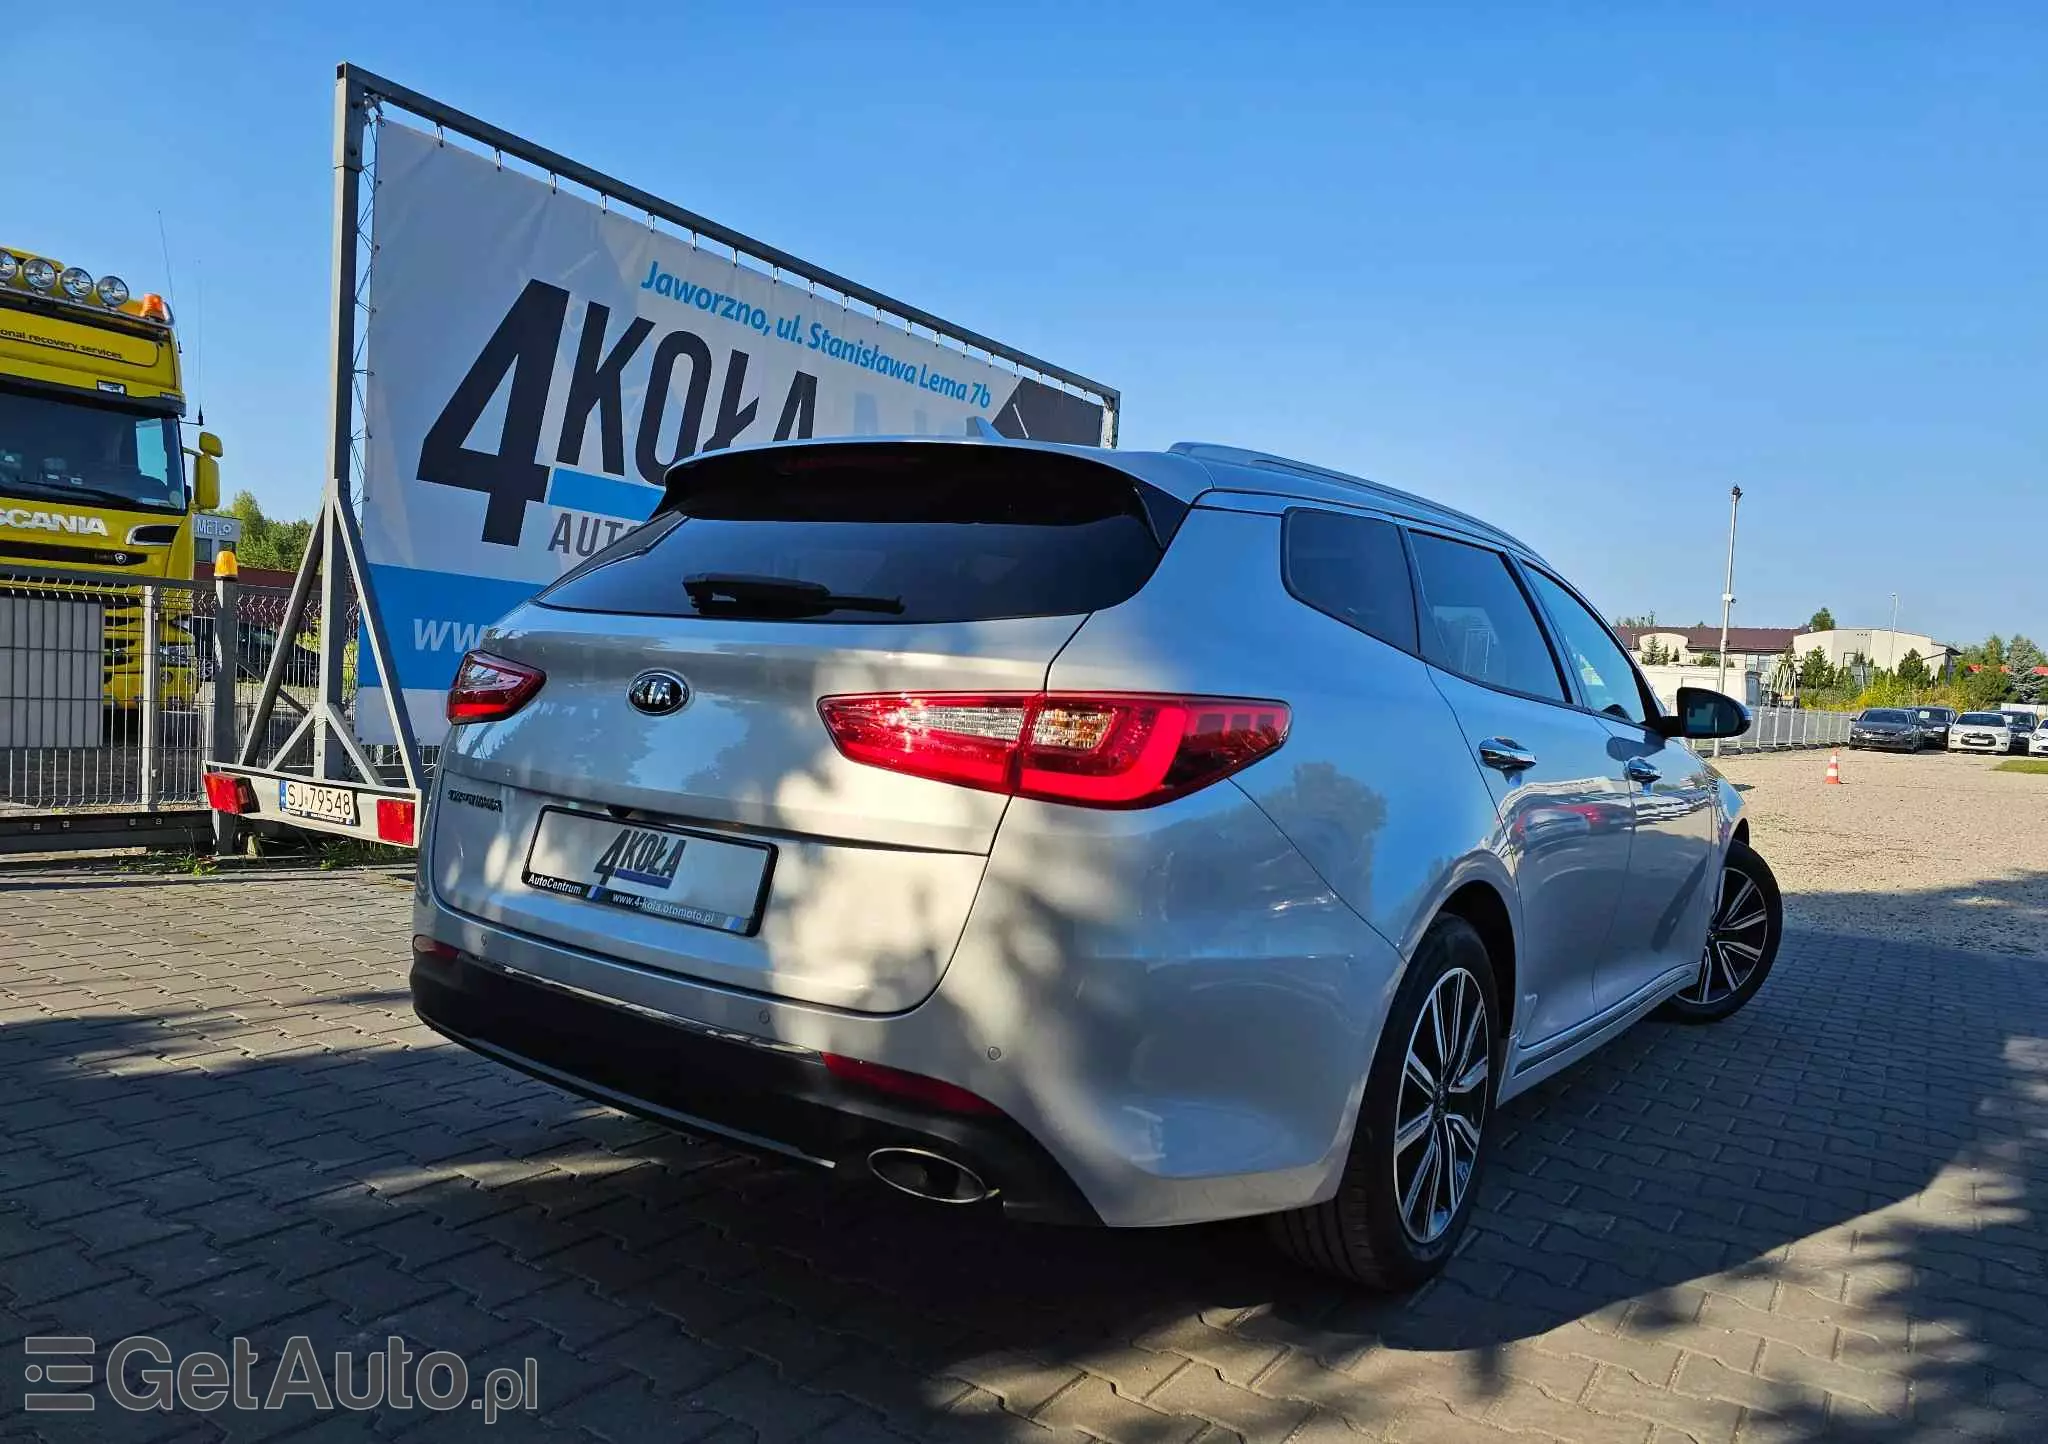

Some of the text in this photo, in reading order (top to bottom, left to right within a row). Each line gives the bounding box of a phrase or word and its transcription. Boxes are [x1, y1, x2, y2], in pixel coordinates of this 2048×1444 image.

[29, 335, 77, 351] recovery
[80, 344, 122, 359] services
[640, 260, 991, 409] Jaworzno, ul. Stanisława Lema 7b
[547, 512, 642, 557] AUT
[634, 681, 671, 705] KIA
[287, 784, 304, 808] SJ
[309, 787, 351, 816] 79548
[528, 875, 582, 896] AutoCentrum
